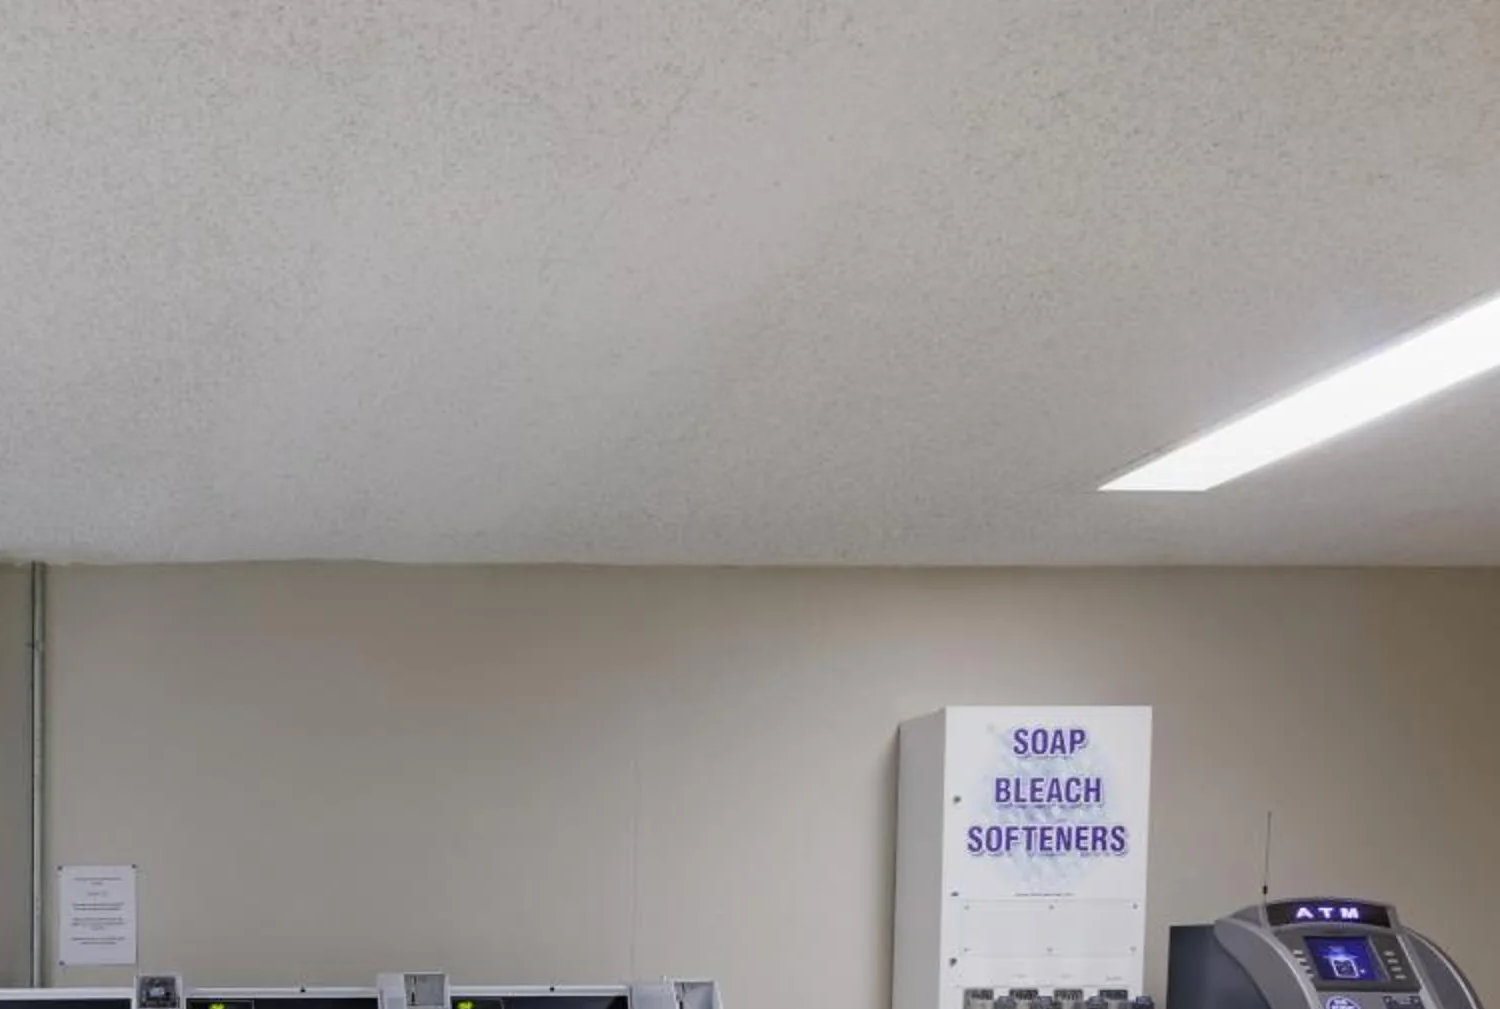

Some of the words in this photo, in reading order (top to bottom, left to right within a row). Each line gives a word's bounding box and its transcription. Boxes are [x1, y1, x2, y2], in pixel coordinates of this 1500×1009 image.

[1013, 728, 1087, 755] SOAP
[995, 778, 1102, 803] BLEACH
[967, 826, 1126, 852] SOFTENERS
[1296, 906, 1359, 919] ATM
